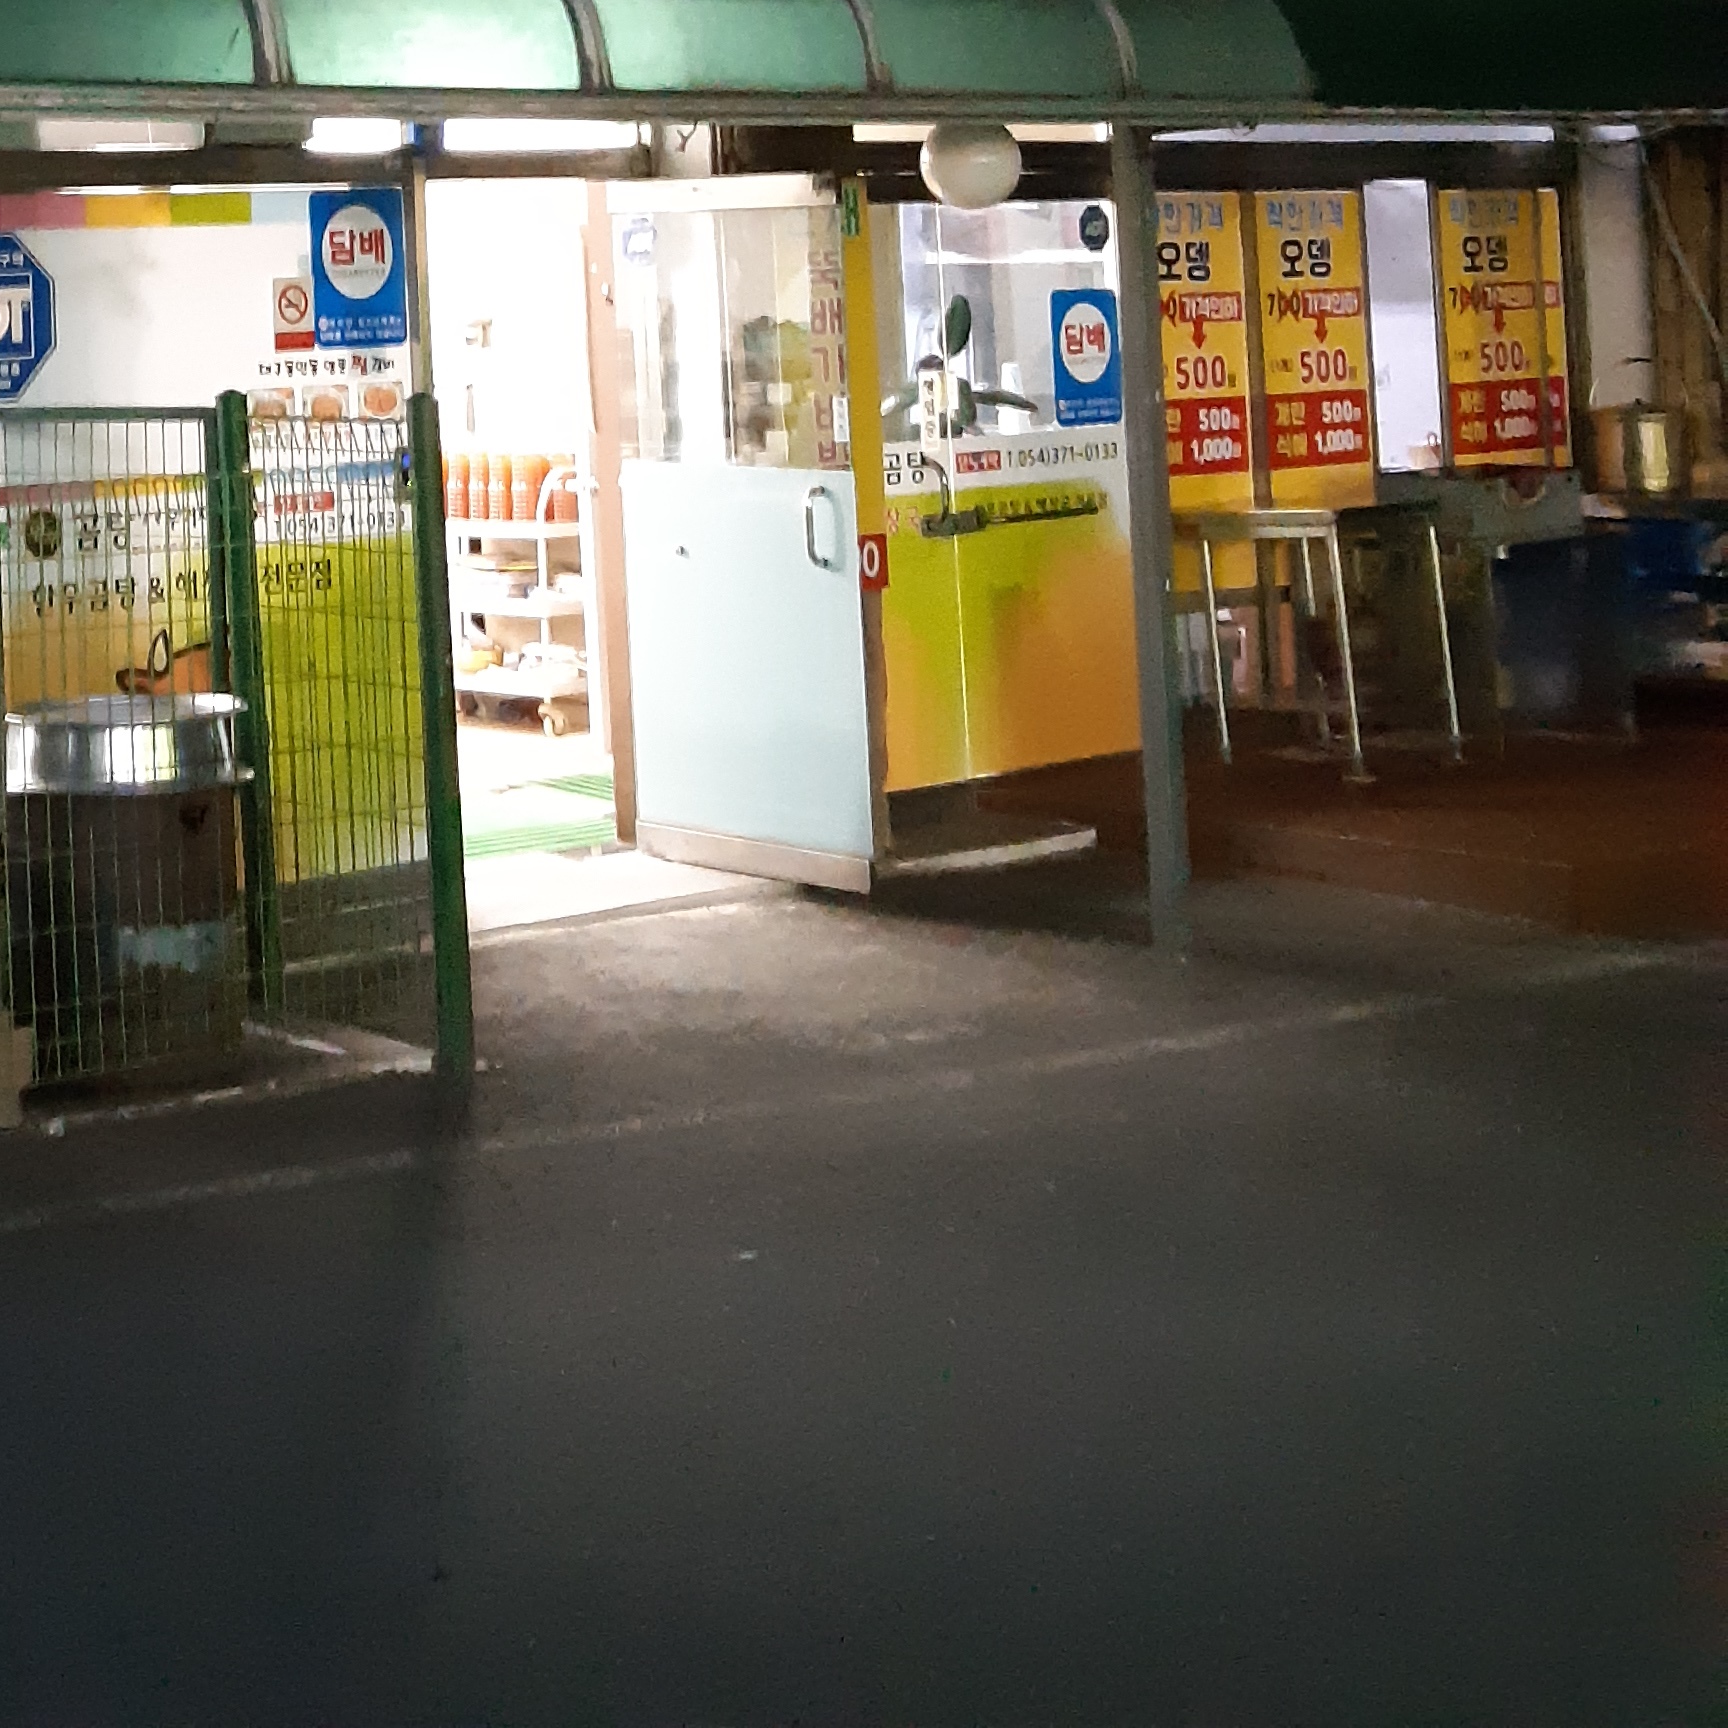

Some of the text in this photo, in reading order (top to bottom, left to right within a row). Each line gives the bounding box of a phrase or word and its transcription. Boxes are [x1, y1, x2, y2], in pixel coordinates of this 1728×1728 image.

[328, 228, 386, 265] 담배
[1157, 241, 1211, 282] 오뎅
[1280, 238, 1332, 279] 오뎅
[1462, 236, 1509, 272] 오뎅
[1064, 322, 1106, 354] 담배
